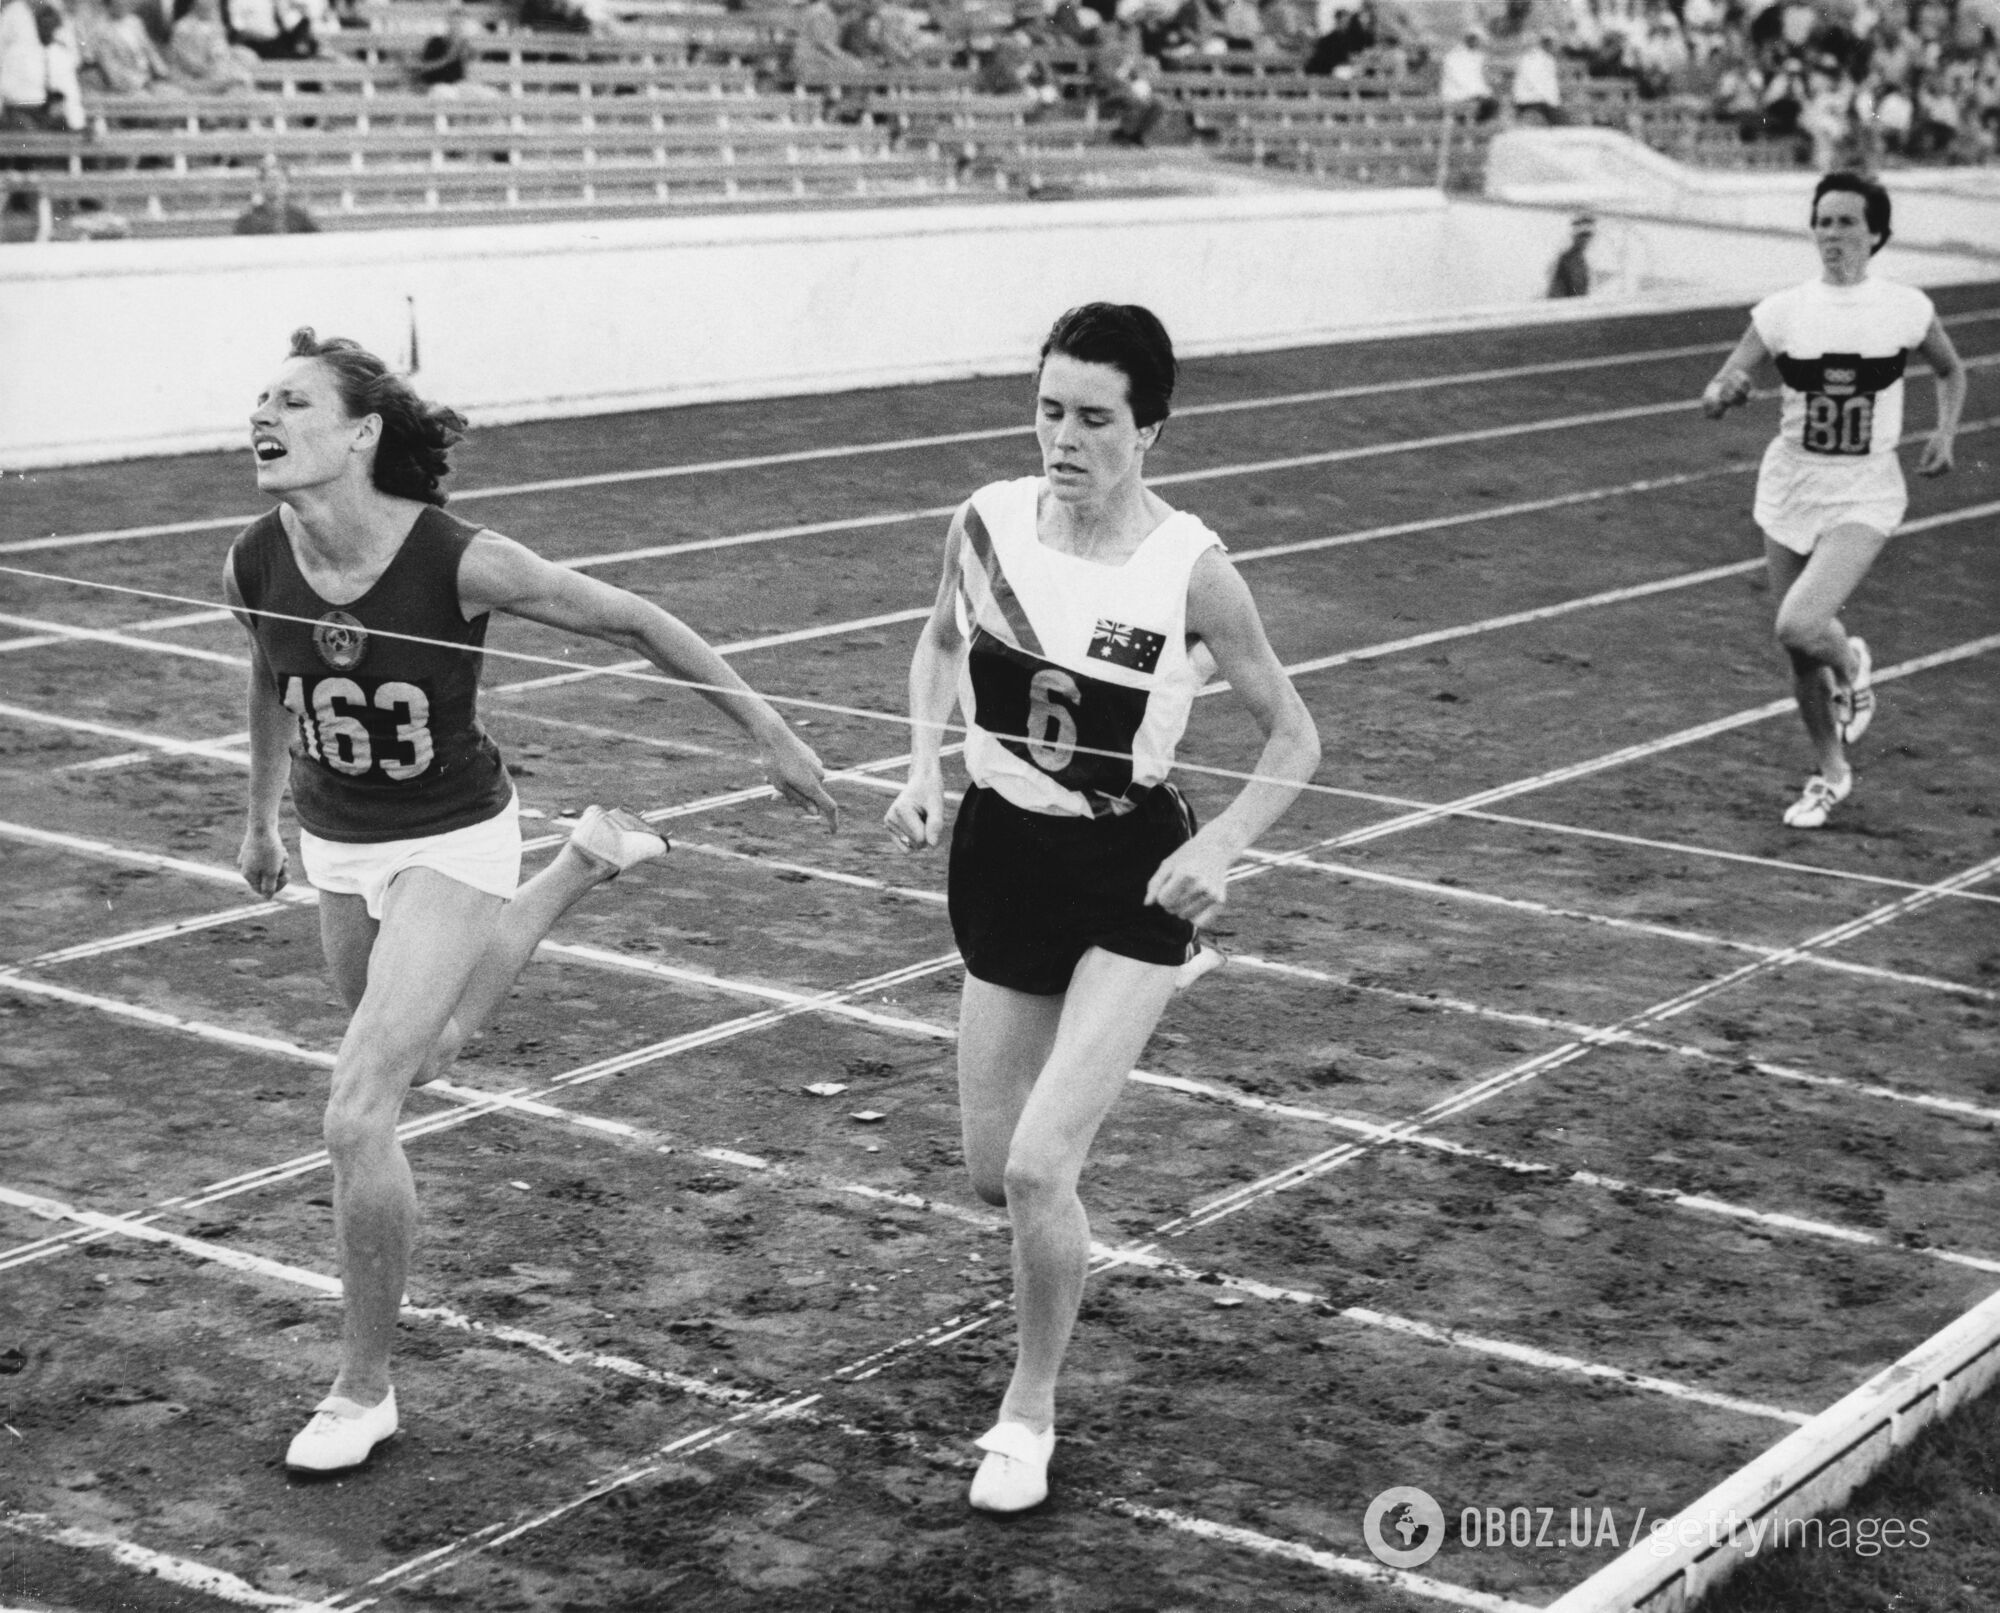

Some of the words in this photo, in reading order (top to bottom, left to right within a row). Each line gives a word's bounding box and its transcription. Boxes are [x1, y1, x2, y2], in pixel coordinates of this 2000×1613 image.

[1807, 396, 1872, 453] 80
[283, 676, 434, 780] 163
[1027, 669, 1081, 772] 6
